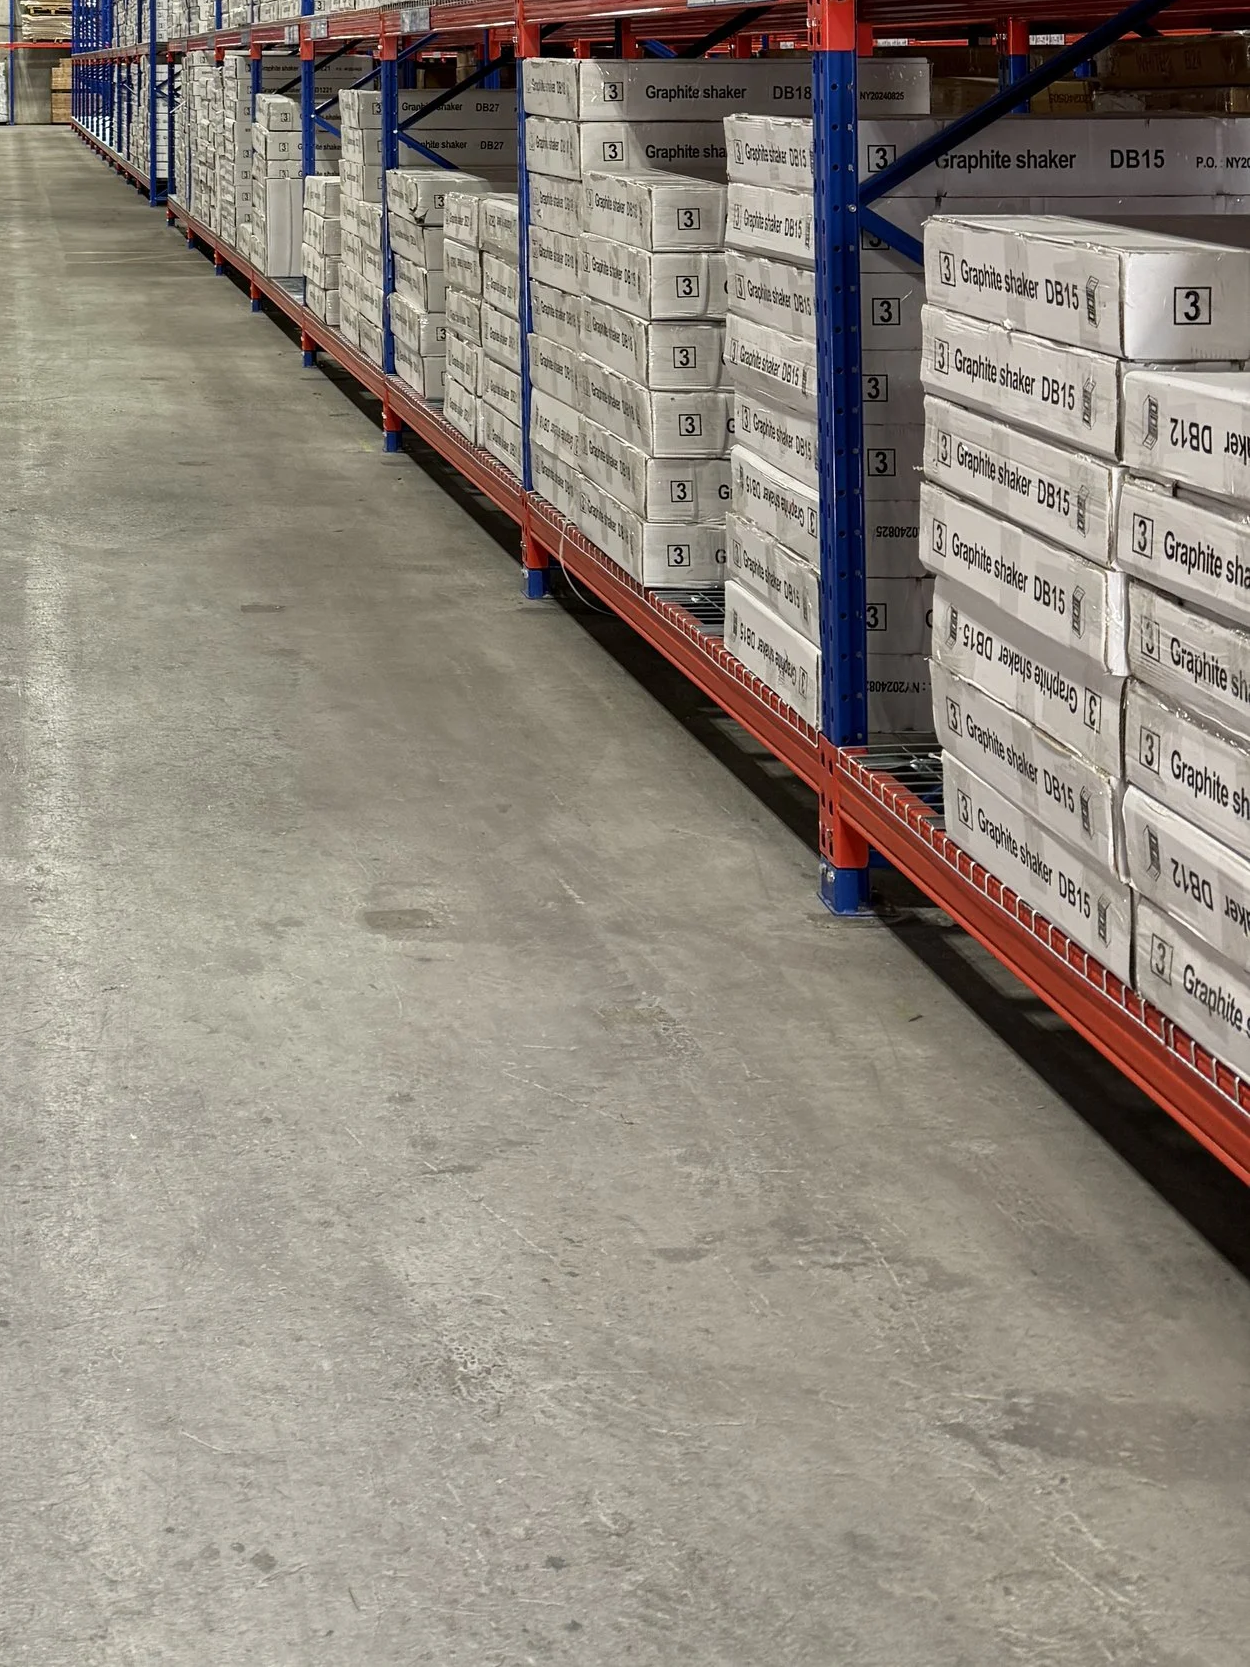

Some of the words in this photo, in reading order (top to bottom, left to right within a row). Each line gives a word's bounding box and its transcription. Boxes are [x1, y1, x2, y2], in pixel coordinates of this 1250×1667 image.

[608, 85, 618, 100] 3
[645, 85, 699, 101] Graphite
[703, 86, 747, 99] shaker
[773, 86, 812, 99] DB18
[875, 148, 888, 169] 3
[1017, 149, 1076, 170] shaker
[1110, 149, 1165, 169] DB15
[943, 257, 952, 281] 3
[961, 259, 1002, 291] Graphite
[1004, 269, 1039, 300] shaker
[1045, 279, 1080, 311] DB15
[1184, 291, 1201, 322] 3
[1170, 417, 1213, 454] DB12
[936, 525, 943, 552] 3
[952, 532, 992, 571] Graphite
[994, 555, 1028, 593] shaker
[1034, 575, 1066, 615] DB15
[961, 796, 970, 824] 3
[978, 808, 1018, 858] Graphite
[1020, 838, 1053, 883] shaker
[1059, 871, 1091, 919] DB15
